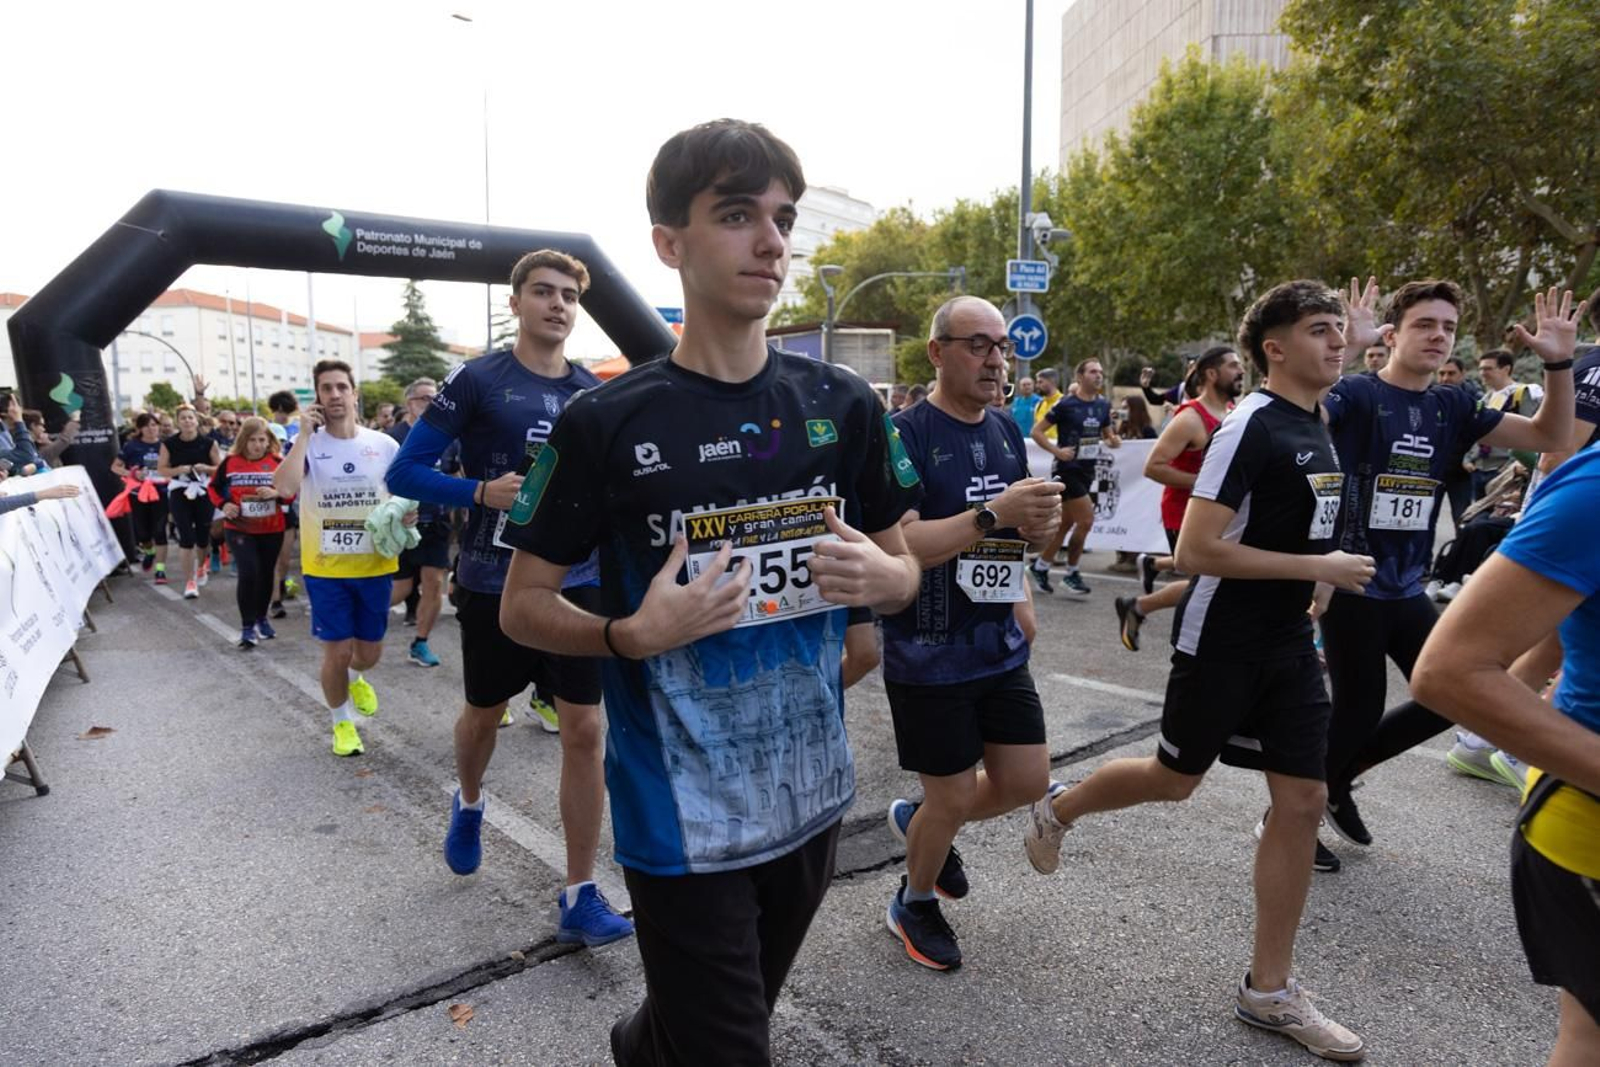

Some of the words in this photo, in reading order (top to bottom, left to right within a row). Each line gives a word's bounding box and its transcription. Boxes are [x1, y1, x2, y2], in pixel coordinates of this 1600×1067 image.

[355, 228, 412, 243] Patronato
[414, 234, 466, 250] Municipal
[469, 239, 482, 250] de
[356, 241, 409, 256] Deportes
[412, 247, 426, 258] de
[428, 248, 455, 260] Jaén
[526, 420, 553, 443] 2
[1391, 434, 1434, 459] 25
[323, 492, 353, 501] SANTA
[965, 474, 1008, 502] 25
[249, 503, 270, 513] 699
[1390, 498, 1422, 518] 181
[691, 516, 726, 539] XXV
[728, 508, 781, 524] CARRERA
[728, 525, 737, 535] y
[744, 520, 775, 533] gran
[781, 512, 824, 525] camina
[1093, 526, 1104, 534] DE
[1106, 525, 1127, 535] JAÉN
[332, 532, 364, 545] 467
[972, 564, 1011, 588] 692
